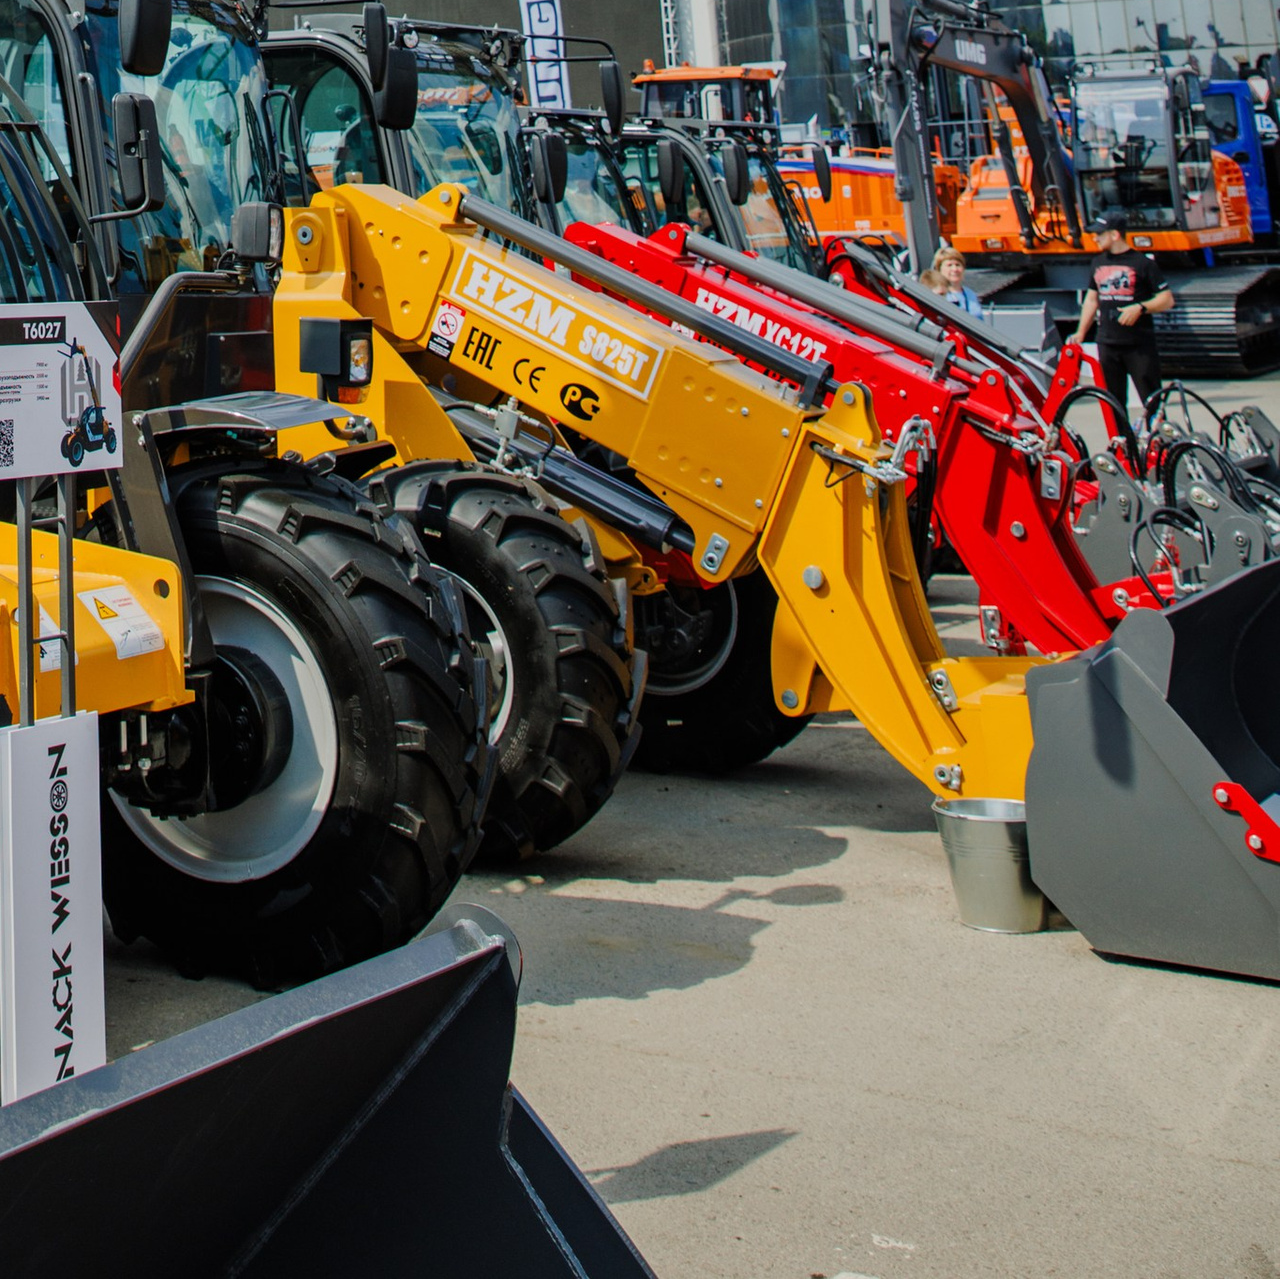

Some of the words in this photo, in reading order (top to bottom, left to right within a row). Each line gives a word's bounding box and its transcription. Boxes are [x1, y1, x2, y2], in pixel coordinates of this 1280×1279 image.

[955, 40, 987, 66] UMG
[22, 322, 62, 340] T6027
[463, 261, 577, 347] HZM
[578, 324, 651, 383] S825T
[695, 287, 766, 337] HZM
[47, 743, 71, 935] WIESSON
